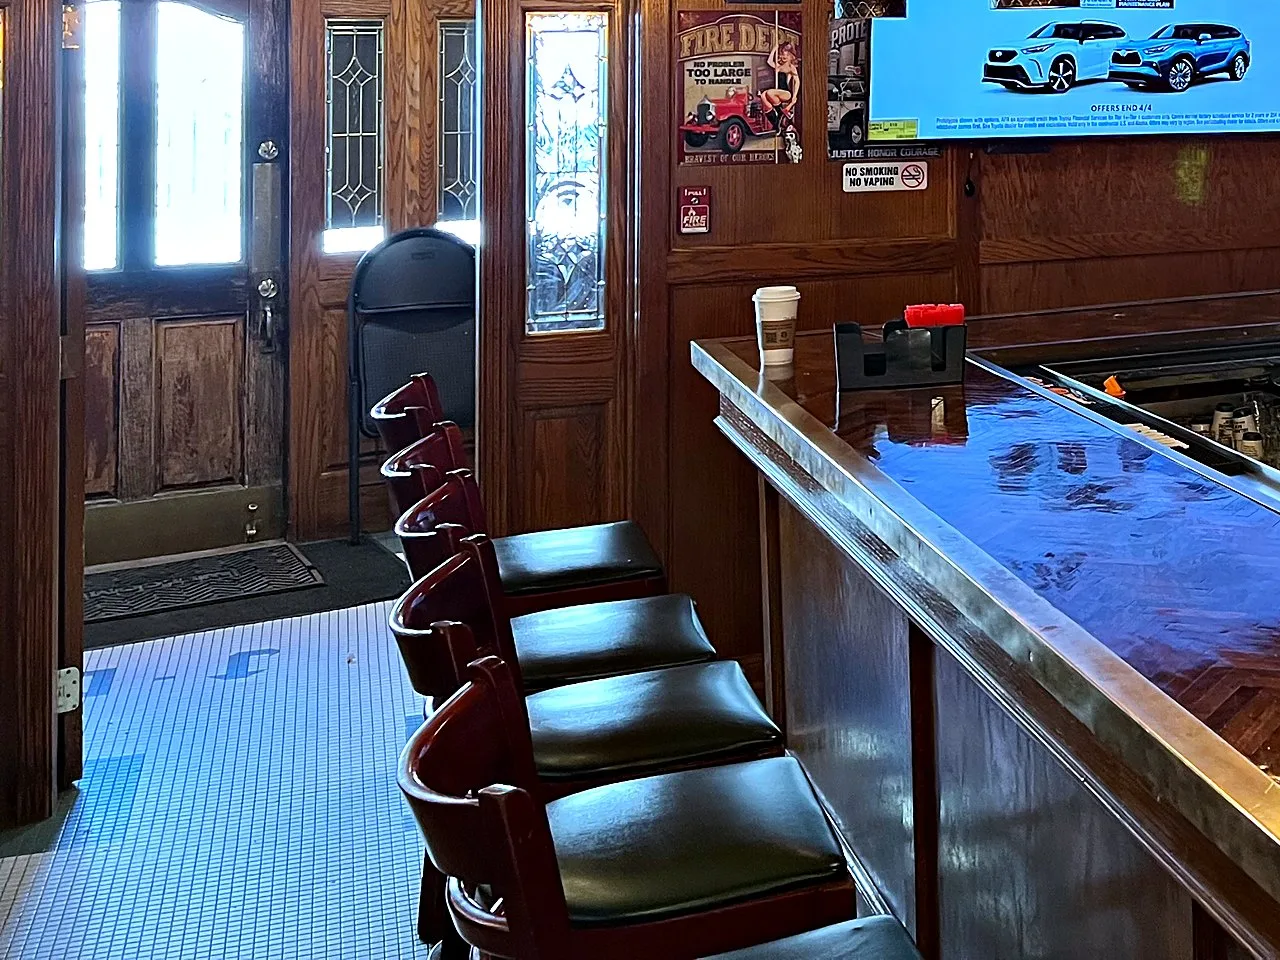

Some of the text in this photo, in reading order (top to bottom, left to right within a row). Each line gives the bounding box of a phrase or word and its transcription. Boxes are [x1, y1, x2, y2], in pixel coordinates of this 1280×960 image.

[680, 23, 734, 57] FIRE
[686, 68, 752, 77] TOO LARGE
[1091, 104, 1152, 112] OFFERS END 4/4
[831, 147, 939, 158] JUSTICE HONOR COURAGE
[845, 166, 899, 177] NO SMOKING
[850, 176, 895, 187] NO VAPING
[683, 215, 707, 224] FIRE
